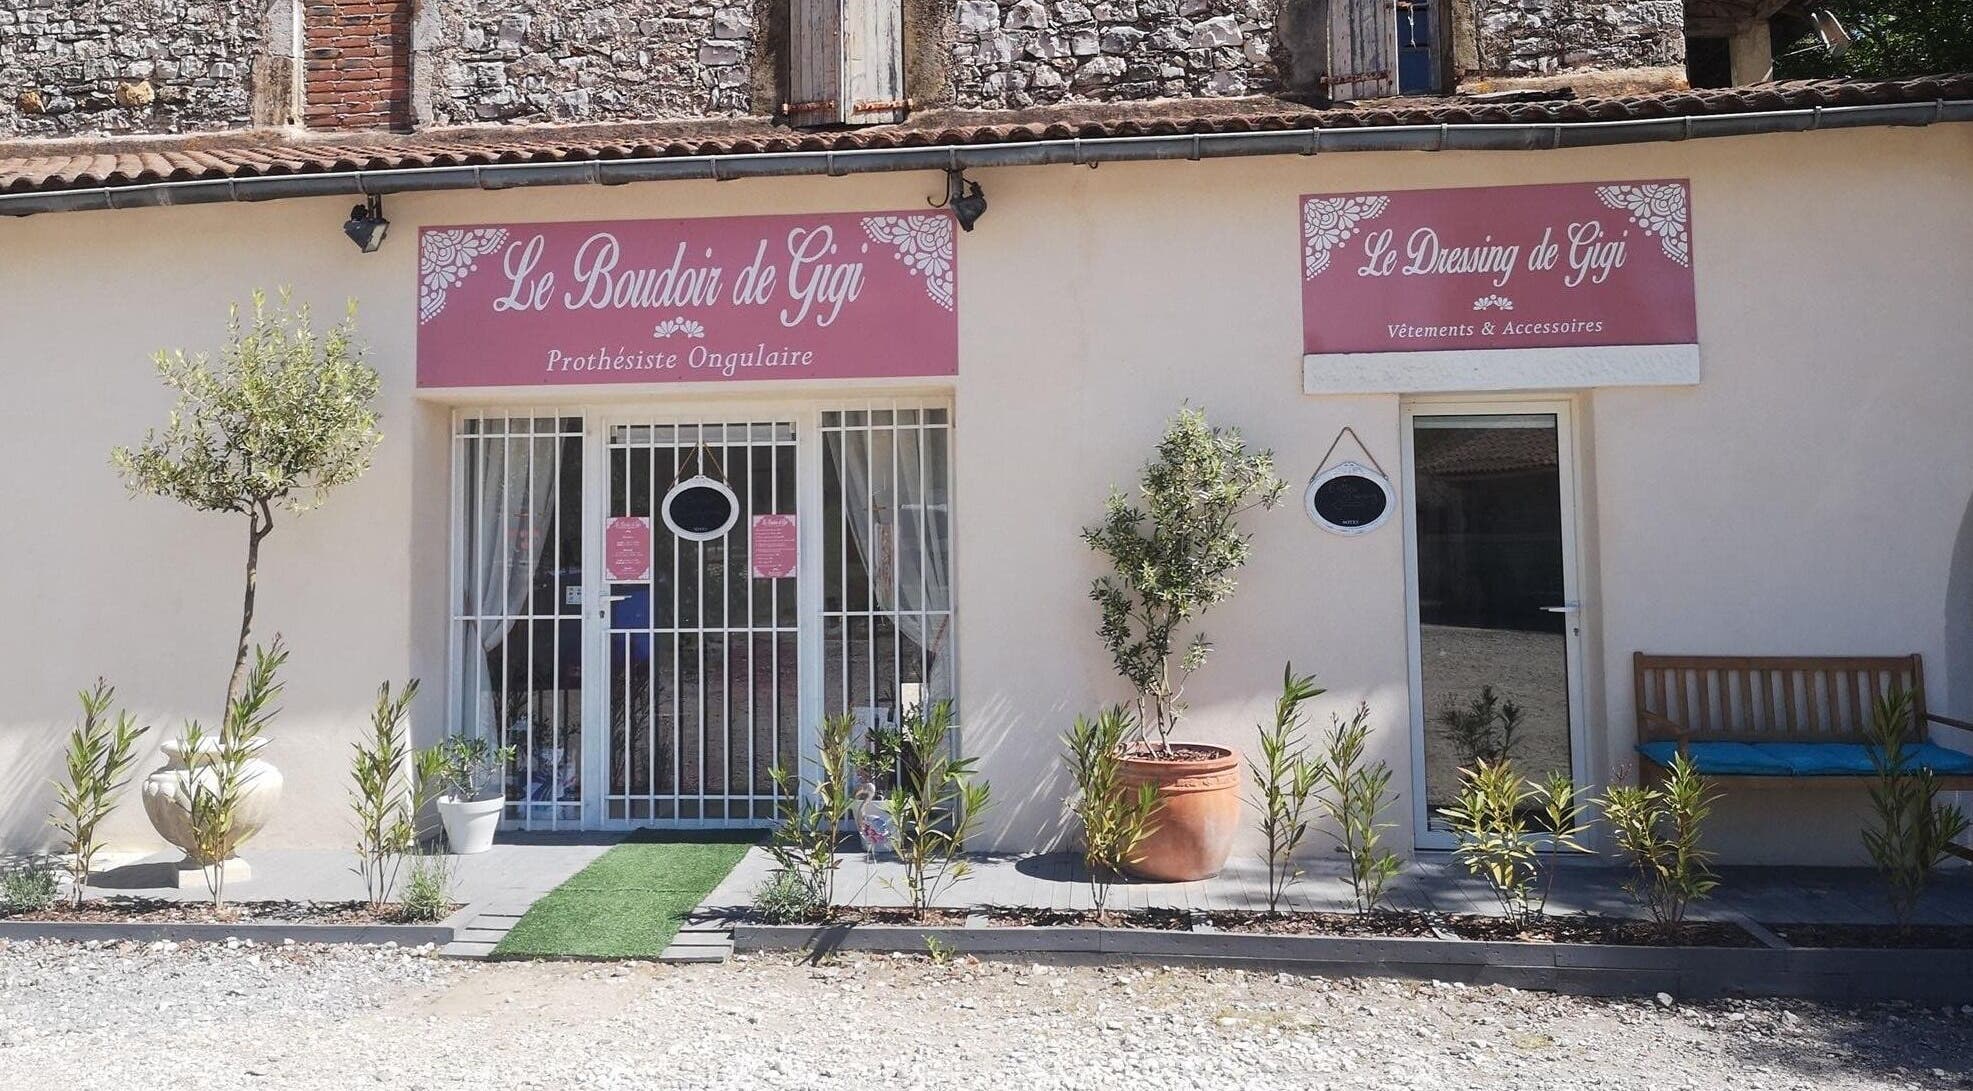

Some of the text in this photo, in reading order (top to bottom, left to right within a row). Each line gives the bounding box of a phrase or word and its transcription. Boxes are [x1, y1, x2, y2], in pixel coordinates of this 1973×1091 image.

[492, 224, 867, 327] Le Boudoir de Gigi
[1357, 220, 1628, 287] Le Dressing de Gigi
[1387, 320, 1603, 338] Vêtements & Accessoires
[546, 343, 813, 377] Prothésiste Ongulaire
